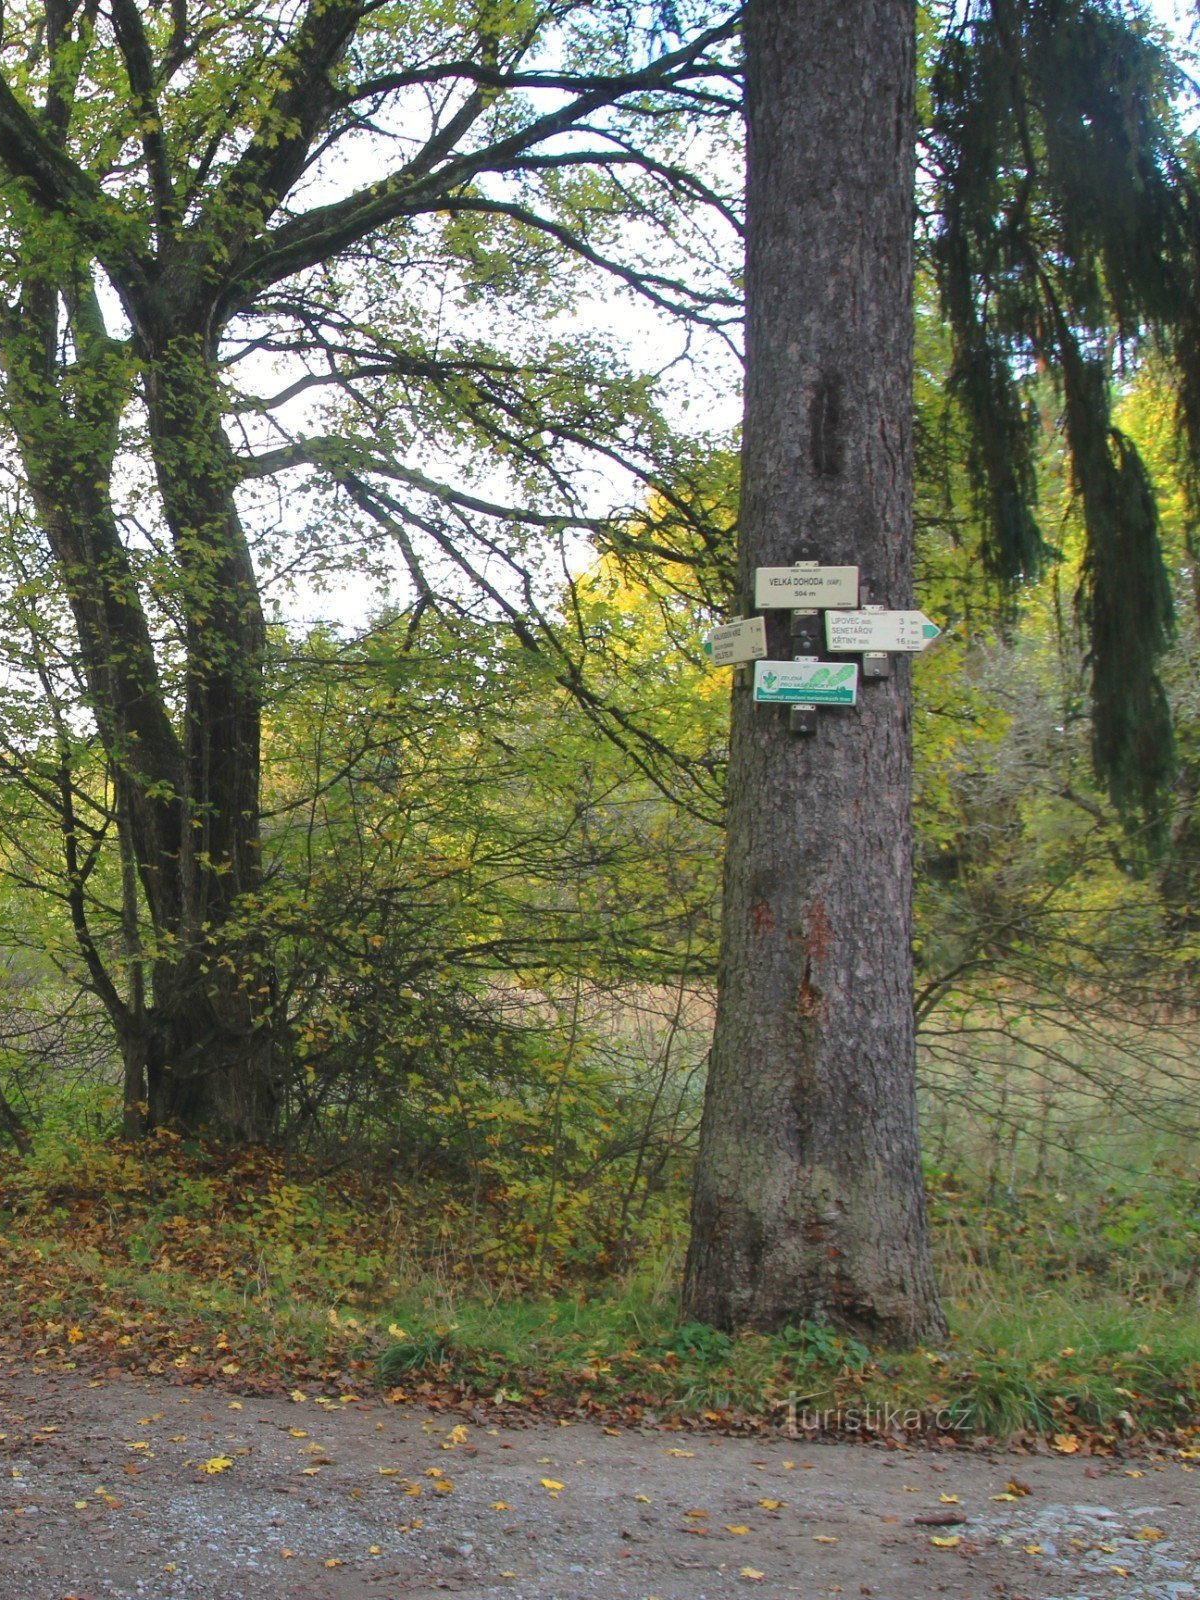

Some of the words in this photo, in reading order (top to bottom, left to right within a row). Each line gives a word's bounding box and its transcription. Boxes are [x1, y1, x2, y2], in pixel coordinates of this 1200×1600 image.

[769, 576, 792, 586] VELKÁ
[793, 577, 823, 586] DOHODA
[831, 617, 860, 625] LIPOVEC
[899, 617, 904, 625] 3
[832, 635, 857, 644] KŘTINY
